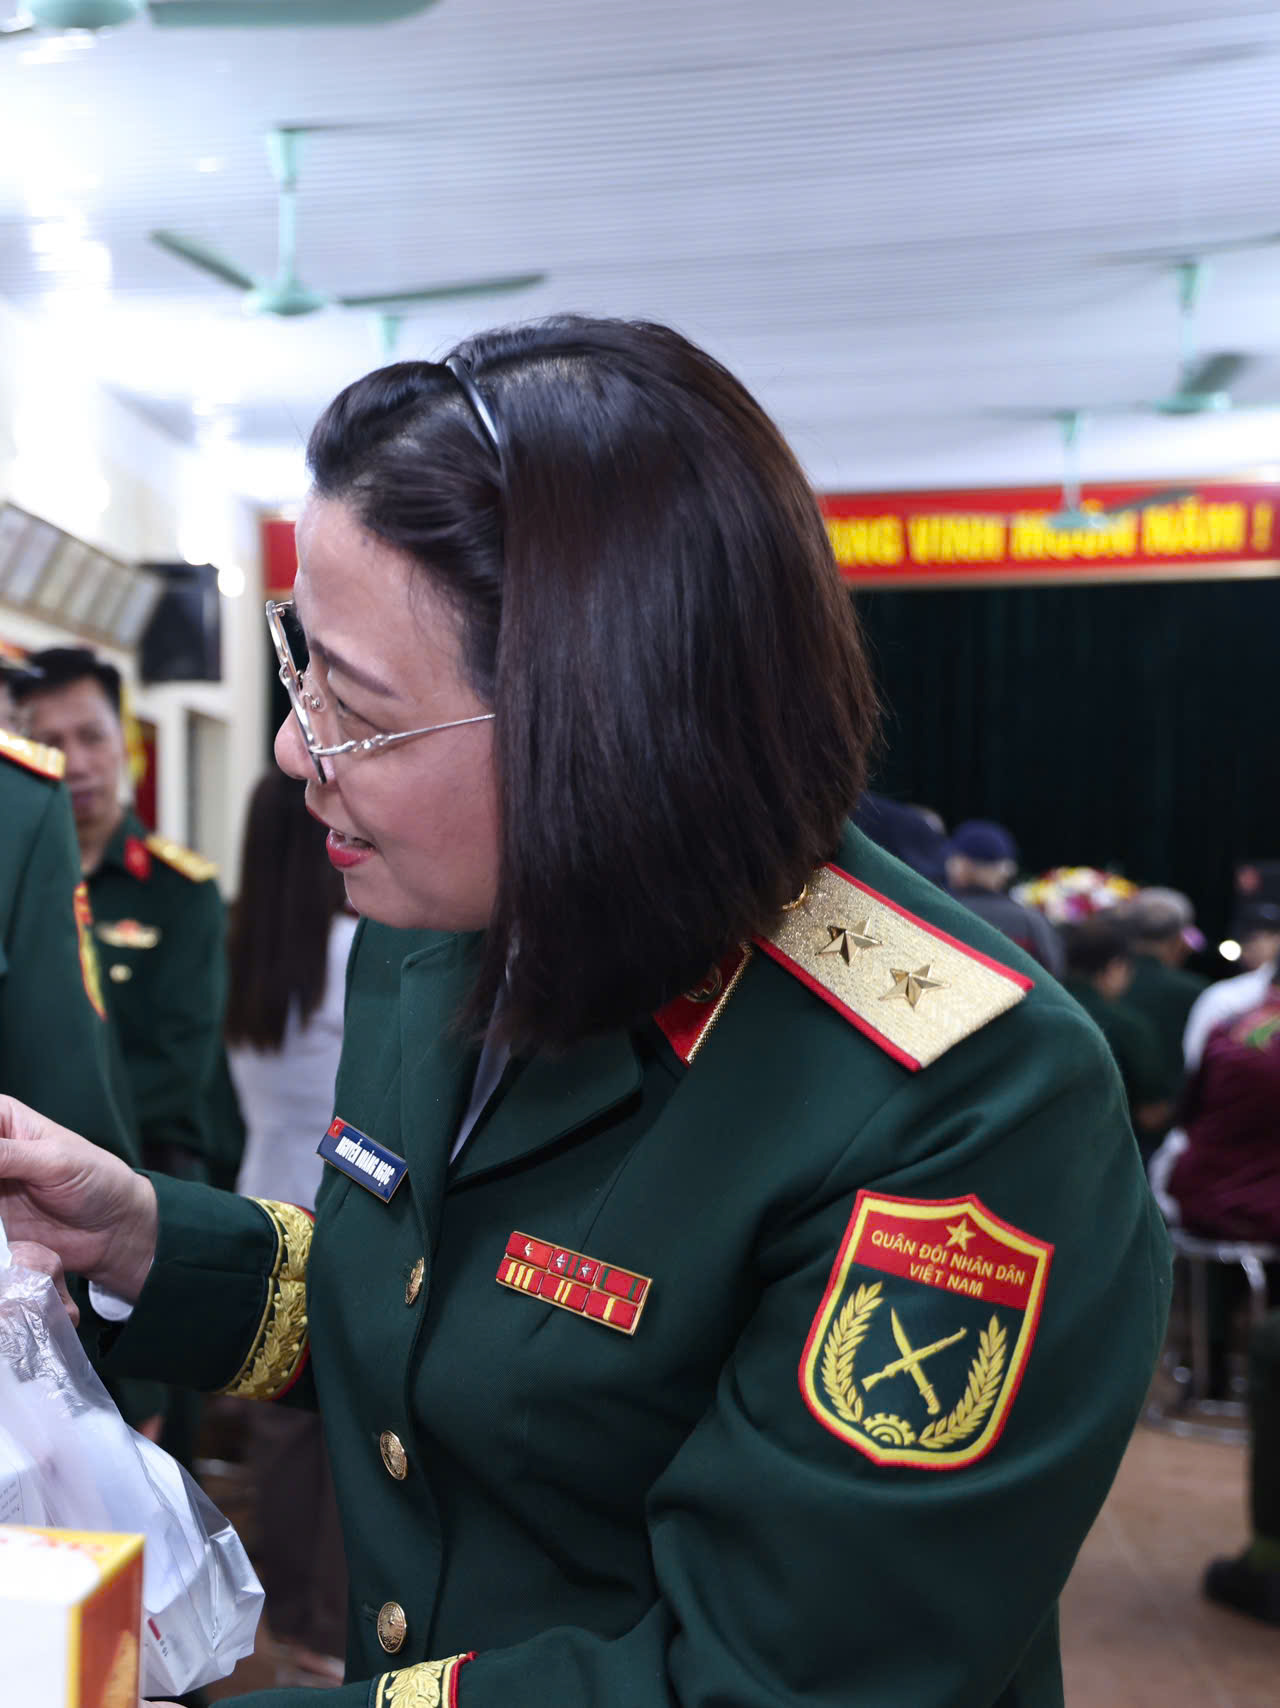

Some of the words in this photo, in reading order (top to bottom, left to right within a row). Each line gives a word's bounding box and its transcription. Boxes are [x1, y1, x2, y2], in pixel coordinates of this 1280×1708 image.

[909, 512, 1006, 564] VINH
[871, 1229, 917, 1256] QUÂN
[918, 1243, 947, 1266] ĐỘI
[950, 1251, 994, 1279] NHÂN
[996, 1262, 1025, 1285] DÂN
[909, 1262, 944, 1285] VIỆT
[947, 1274, 983, 1297] NAM
